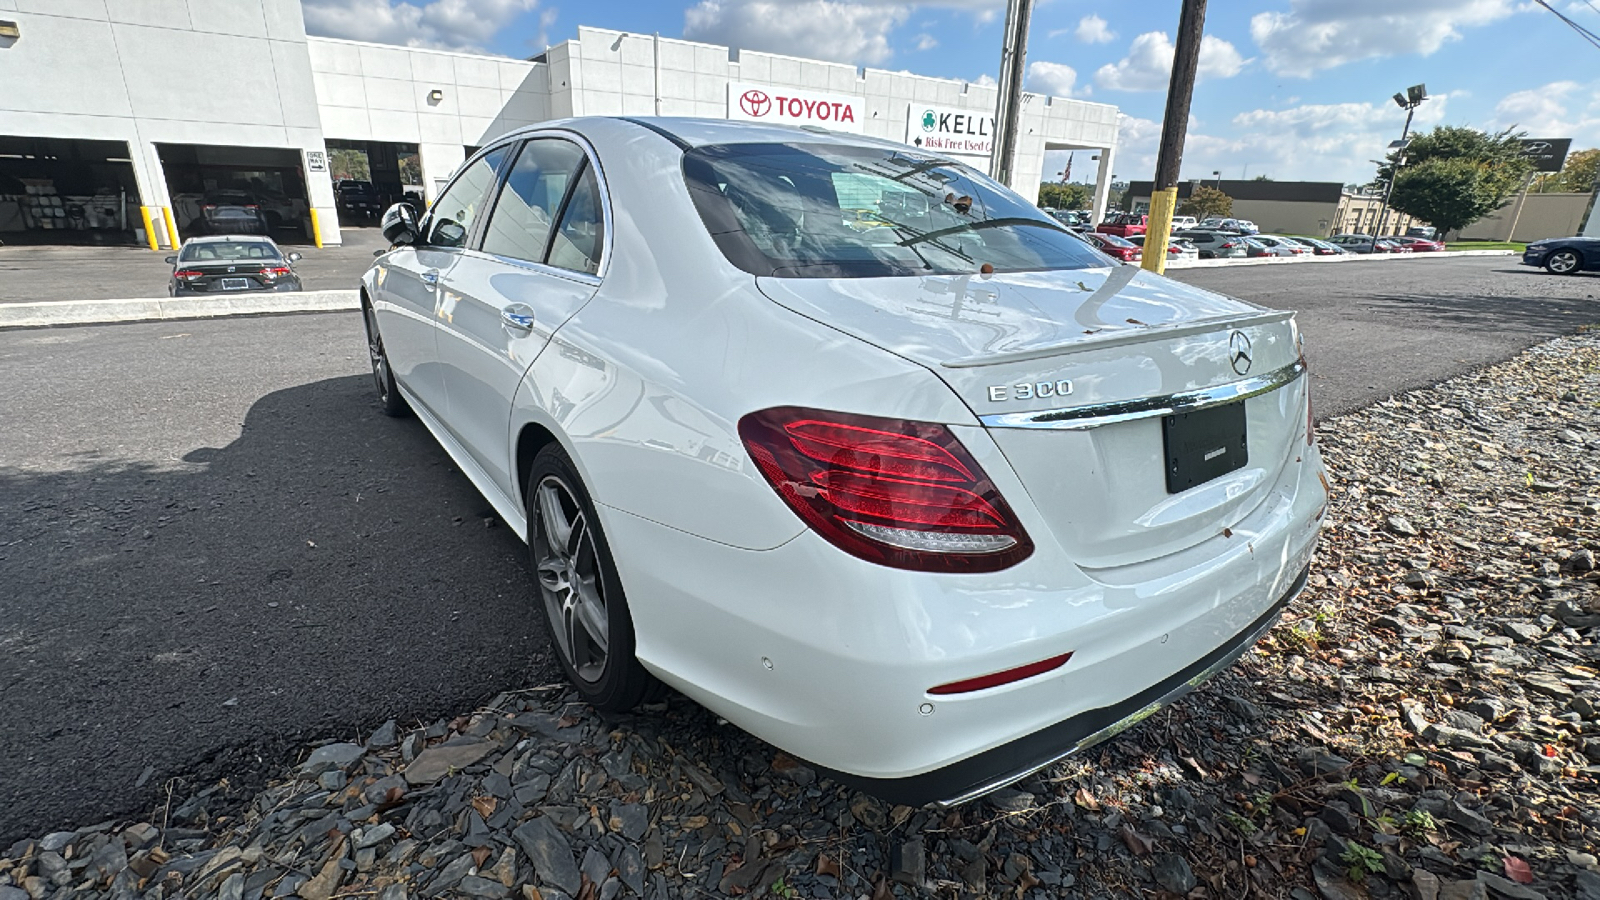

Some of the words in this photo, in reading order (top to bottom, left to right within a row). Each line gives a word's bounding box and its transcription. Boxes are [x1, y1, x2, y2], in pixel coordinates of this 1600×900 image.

[775, 96, 854, 123] TOYOTA
[925, 136, 943, 148] Risk
[945, 138, 962, 149] Free
[964, 140, 984, 151] Used
[988, 385, 1008, 402] E
[1014, 379, 1074, 400] 300
